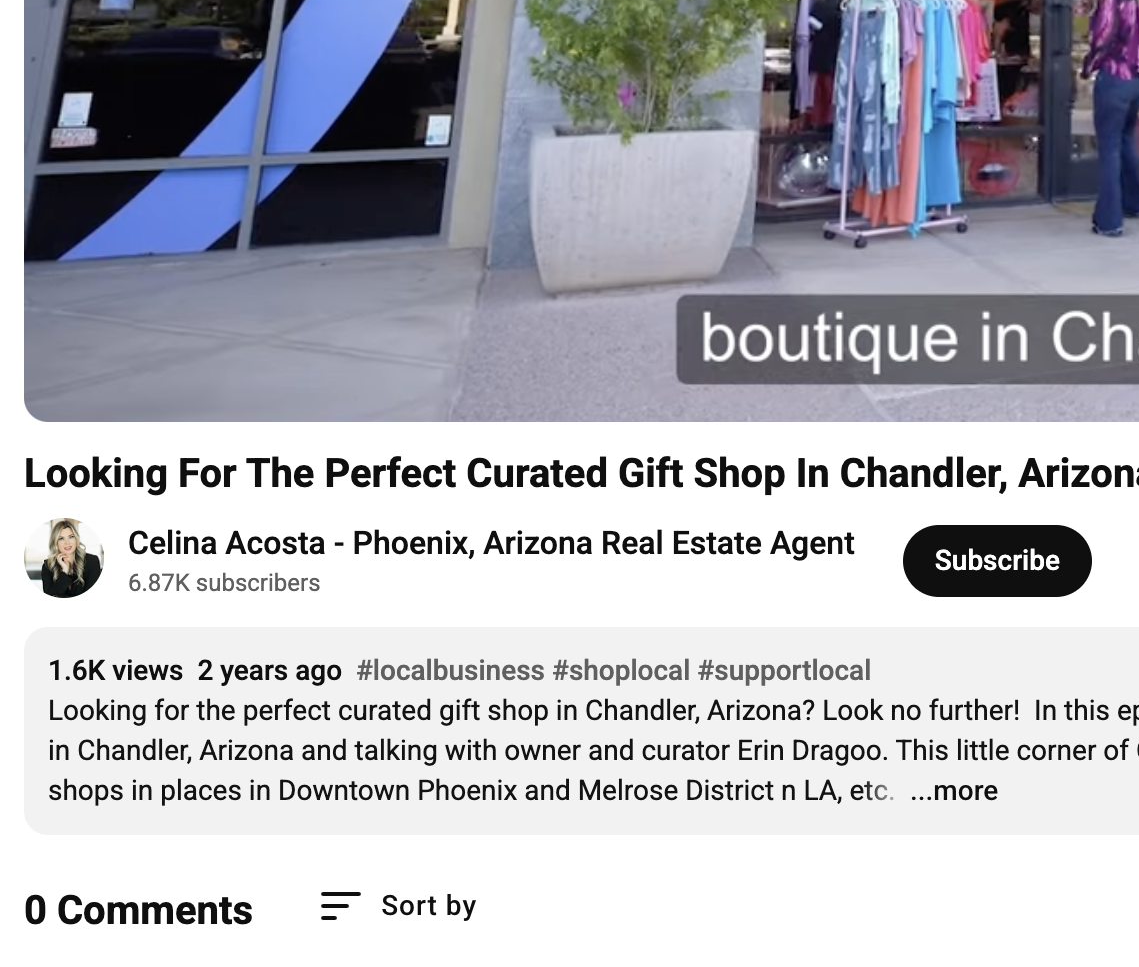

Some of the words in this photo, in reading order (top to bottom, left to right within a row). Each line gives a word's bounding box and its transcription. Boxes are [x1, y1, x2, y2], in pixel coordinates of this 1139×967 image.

[25, 455, 167, 497] Looking
[179, 457, 238, 489] For
[245, 455, 315, 489] The
[326, 455, 457, 489] Perfect
[466, 455, 607, 489] Curated
[618, 455, 684, 489] Gift
[693, 455, 786, 496] Shop
[797, 457, 829, 488] In
[840, 455, 1008, 495] Chandler,
[128, 528, 218, 556] Celina
[224, 529, 326, 556] Acosta
[333, 540, 346, 548] -
[353, 528, 475, 560] Phoenix,
[482, 529, 593, 556] Arizona
[602, 528, 663, 556] Real
[673, 529, 762, 556] Estate
[769, 529, 856, 562] Agent
[934, 547, 1061, 572] Subscribe
[128, 572, 191, 592] 6.87K
[196, 571, 321, 592] subscribers
[49, 659, 107, 681] 1.6K
[111, 658, 184, 682] views
[197, 658, 214, 681] 2
[219, 663, 288, 687] years
[295, 663, 343, 687] ago
[356, 657, 545, 681] #localbusiness
[552, 657, 690, 687] #shoplocal
[697, 657, 871, 687] #supportlocal
[49, 697, 147, 727] Looking
[154, 697, 190, 721] for
[195, 697, 236, 722] the
[243, 697, 331, 727] perfect
[338, 697, 431, 722] curated
[439, 697, 481, 727] gift
[487, 697, 549, 727] shop
[556, 698, 578, 721] in
[585, 697, 700, 725] Chandler,
[706, 698, 816, 721] Arizona?
[823, 697, 885, 721] Look
[891, 703, 922, 721] no
[928, 697, 1020, 722] further!
[1035, 698, 1057, 721] In
[1063, 697, 1110, 722] this
[49, 738, 70, 761] in
[77, 737, 192, 765] Chandler,
[198, 738, 294, 761] Arizona
[301, 737, 347, 761] and
[353, 737, 437, 767] talking
[444, 737, 497, 762] with
[504, 743, 582, 761] owner
[588, 737, 634, 761] and
[641, 740, 731, 762] curator
[738, 738, 784, 761] Erin
[792, 738, 888, 767] Dragoo.
[895, 737, 949, 761] This
[957, 737, 1010, 762] little
[1016, 743, 1098, 761] corner
[1103, 737, 1130, 761] of
[48, 777, 124, 807] shops
[132, 778, 153, 801] in
[161, 777, 242, 807] places
[249, 778, 271, 801] in
[279, 778, 410, 802] Downtown
[418, 777, 518, 801] Phoenix
[524, 777, 570, 801] and
[579, 777, 679, 801] Melrose
[686, 778, 775, 802] District
[781, 783, 796, 801] n
[804, 778, 843, 805] LA,
[849, 780, 896, 801] etc.
[911, 784, 999, 802] ...more
[24, 893, 47, 926] 0
[57, 893, 253, 926] Comments
[381, 894, 437, 917] Sort
[446, 893, 477, 922] by
